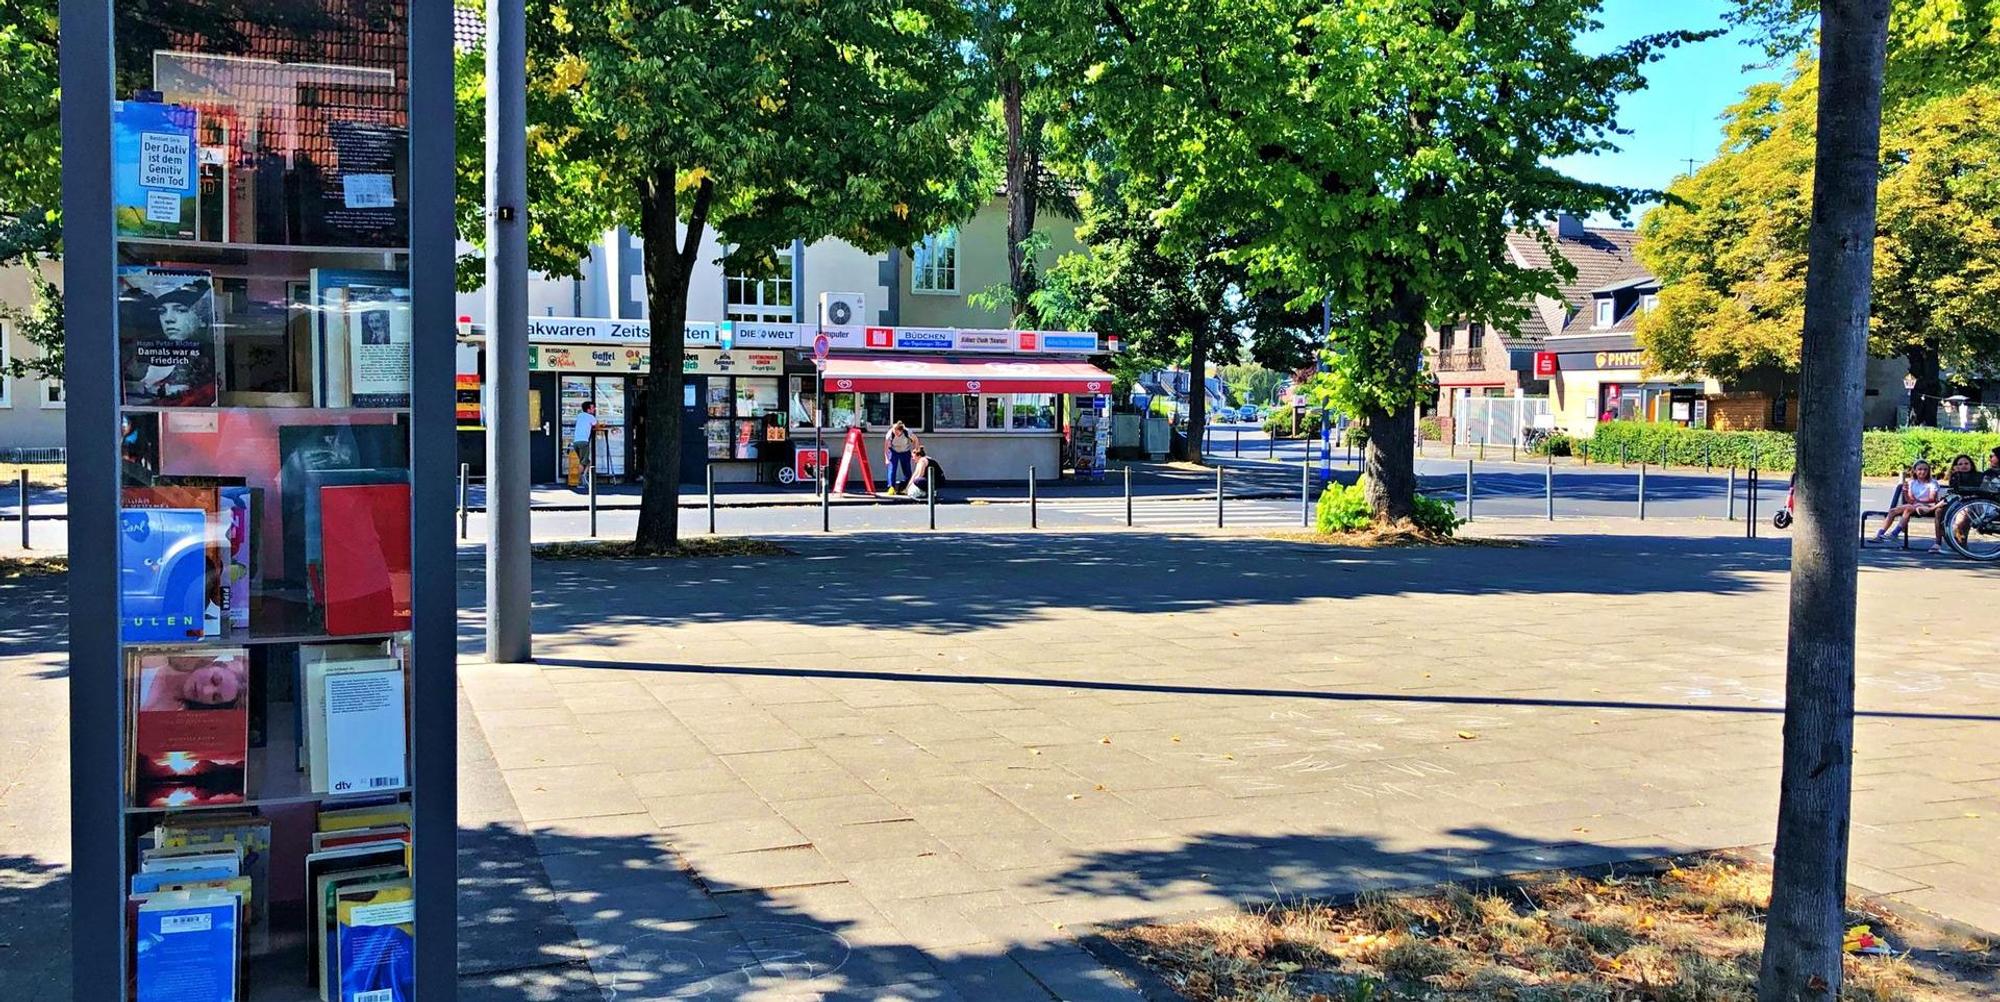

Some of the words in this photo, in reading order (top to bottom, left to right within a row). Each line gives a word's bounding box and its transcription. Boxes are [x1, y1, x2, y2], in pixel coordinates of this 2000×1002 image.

[144, 141, 160, 152] Der
[162, 143, 187, 155] Dativ
[149, 152, 160, 163] ist
[162, 154, 183, 165] dem
[148, 163, 182, 175] Genitiv
[145, 174, 165, 185] sein
[168, 176, 184, 187] Tod
[528, 321, 596, 337] akwaren
[740, 329, 756, 338] DIE
[905, 331, 946, 340] BÜDCHEN
[137, 347, 171, 356] Damals
[592, 351, 615, 362] Gaffel
[150, 356, 189, 365] Friedrich
[335, 780, 352, 791] dtv
